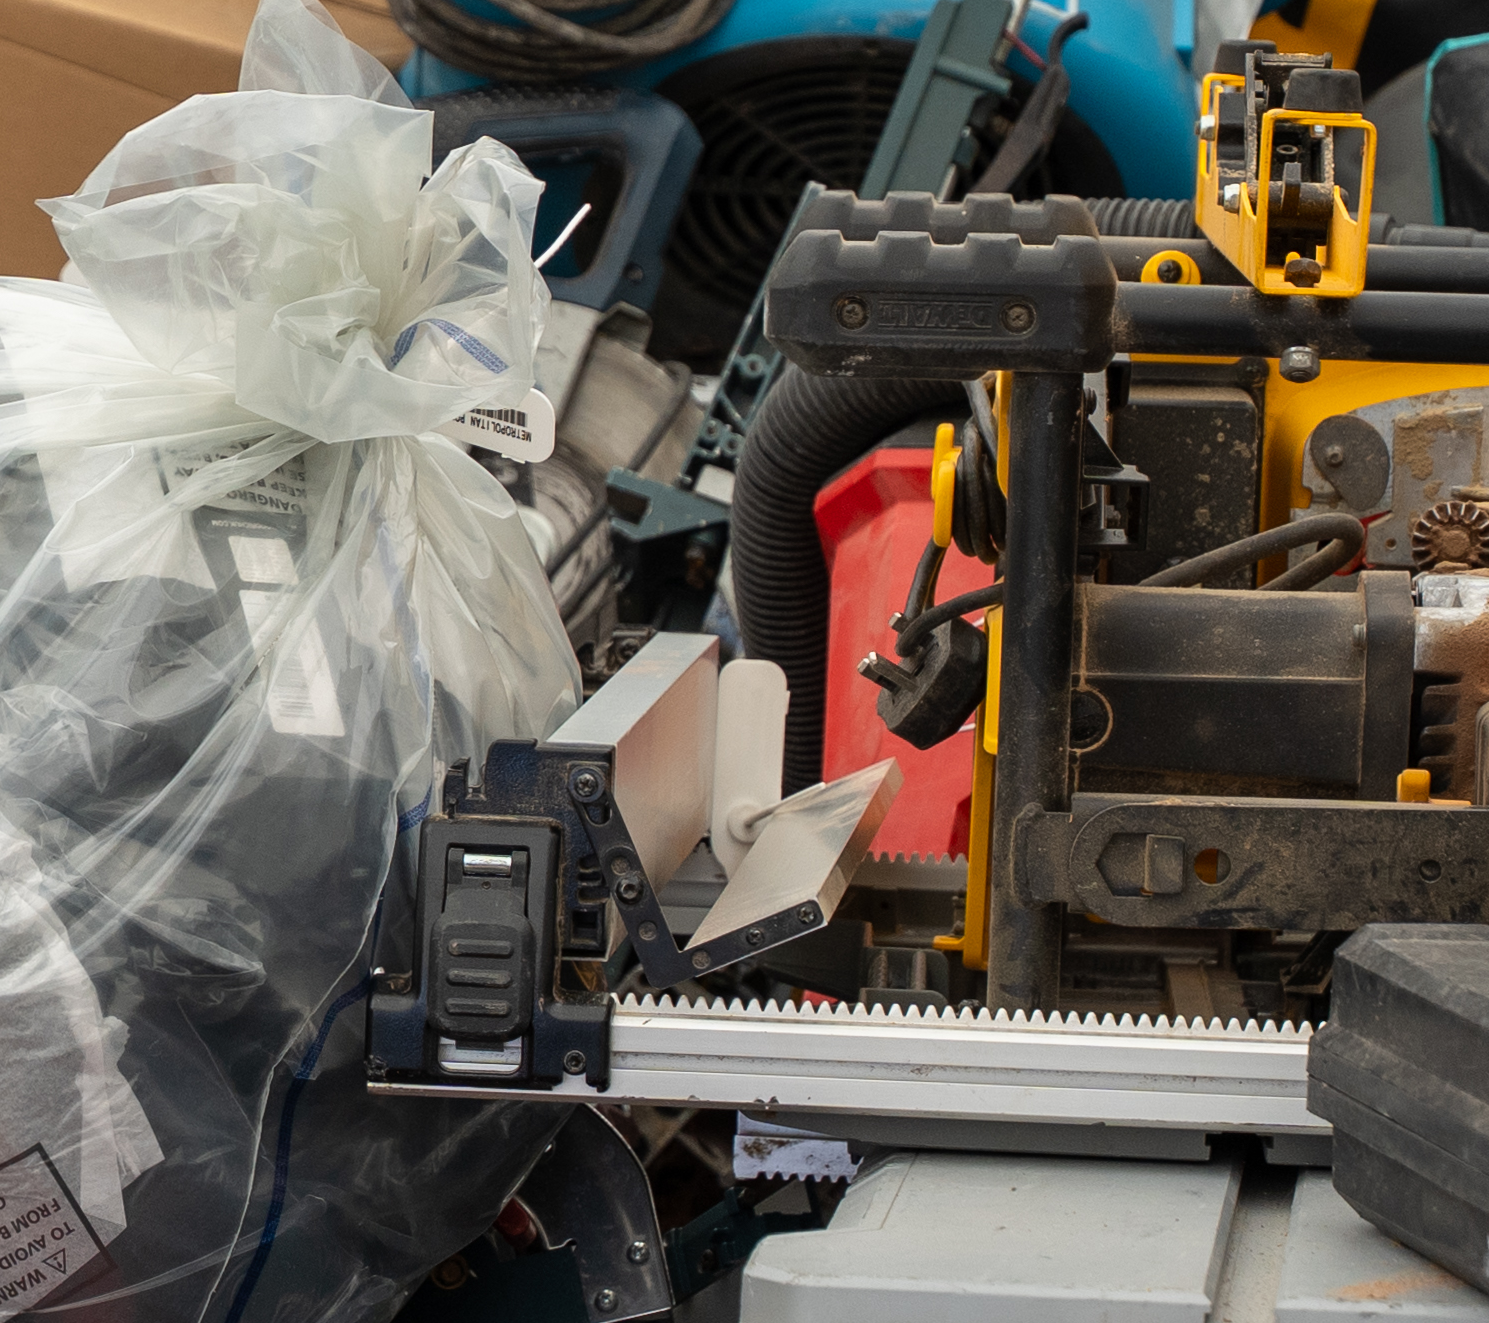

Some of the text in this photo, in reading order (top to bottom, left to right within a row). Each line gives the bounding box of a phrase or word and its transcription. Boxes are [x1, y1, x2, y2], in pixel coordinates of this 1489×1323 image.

[469, 415, 532, 443] METROPOLITAN
[7, 1196, 63, 1234] FROM
[47, 1218, 77, 1242] TO
